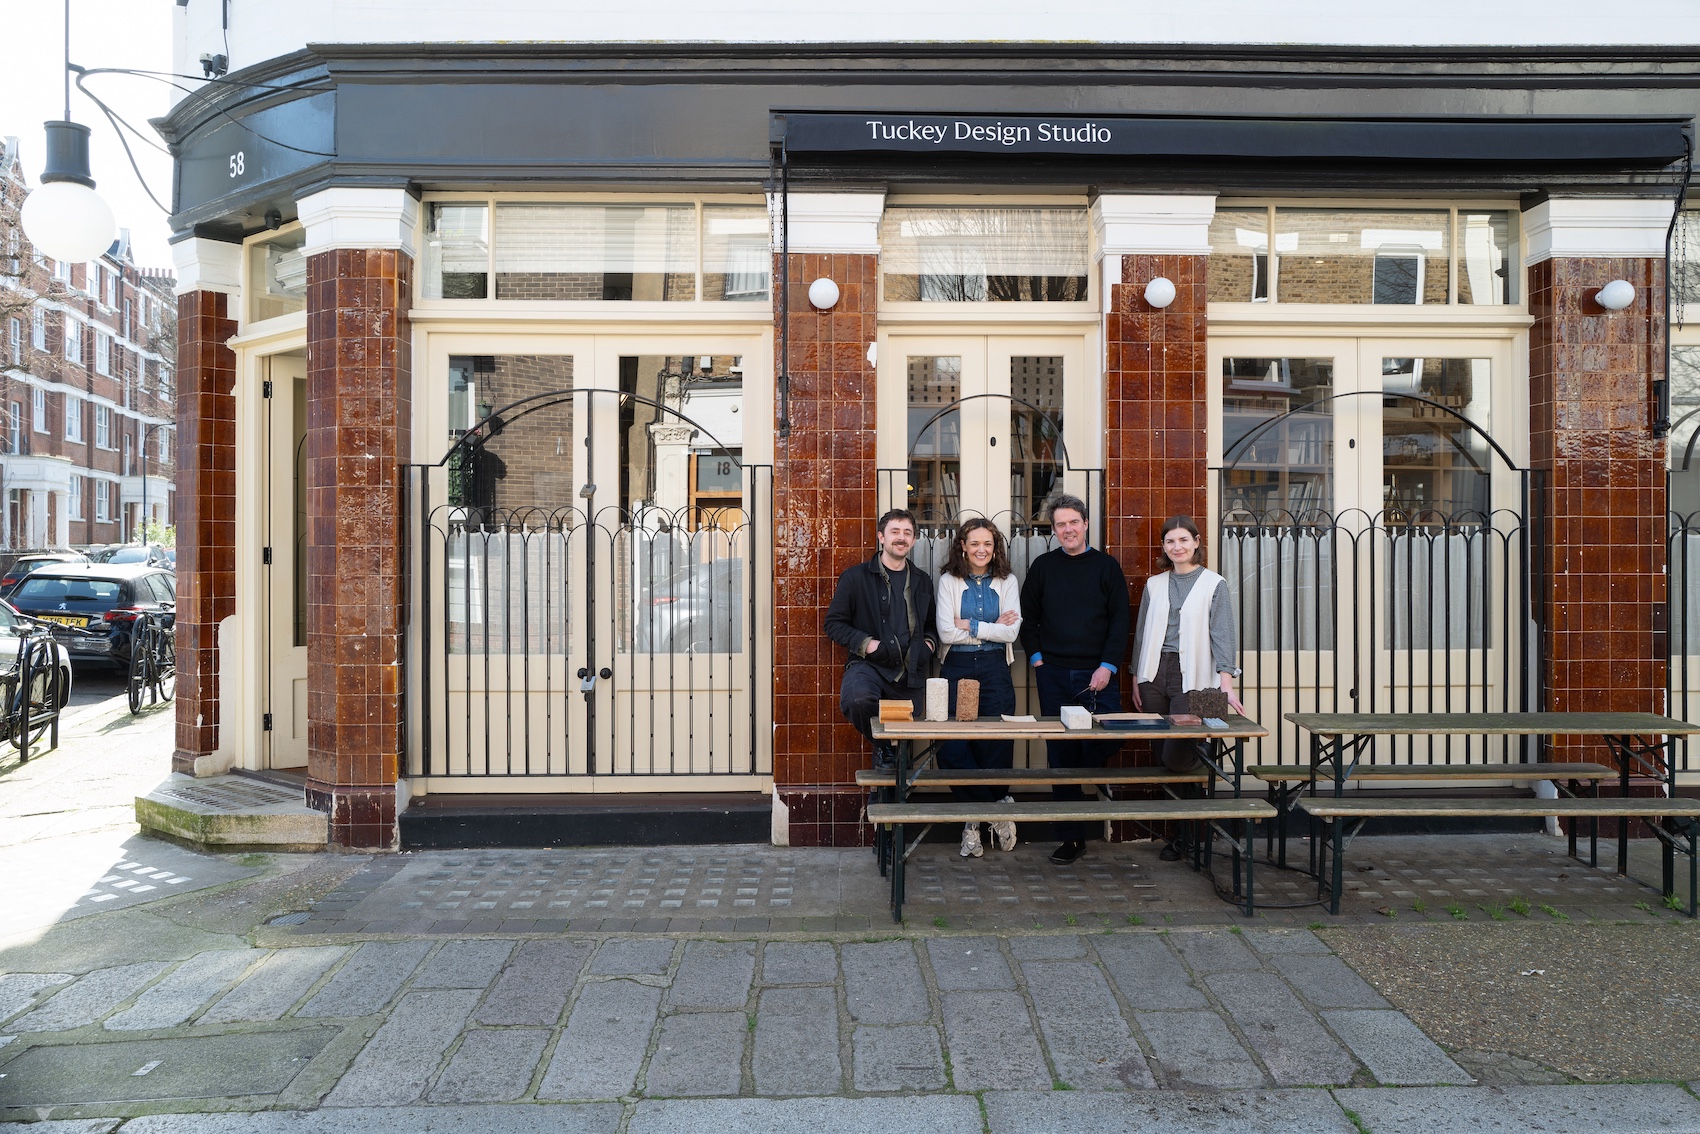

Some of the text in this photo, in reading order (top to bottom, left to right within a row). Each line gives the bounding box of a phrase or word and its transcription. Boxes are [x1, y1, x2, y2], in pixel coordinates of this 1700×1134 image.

[866, 120, 1112, 146] Tuckey Design Studio
[229, 151, 245, 178] 58
